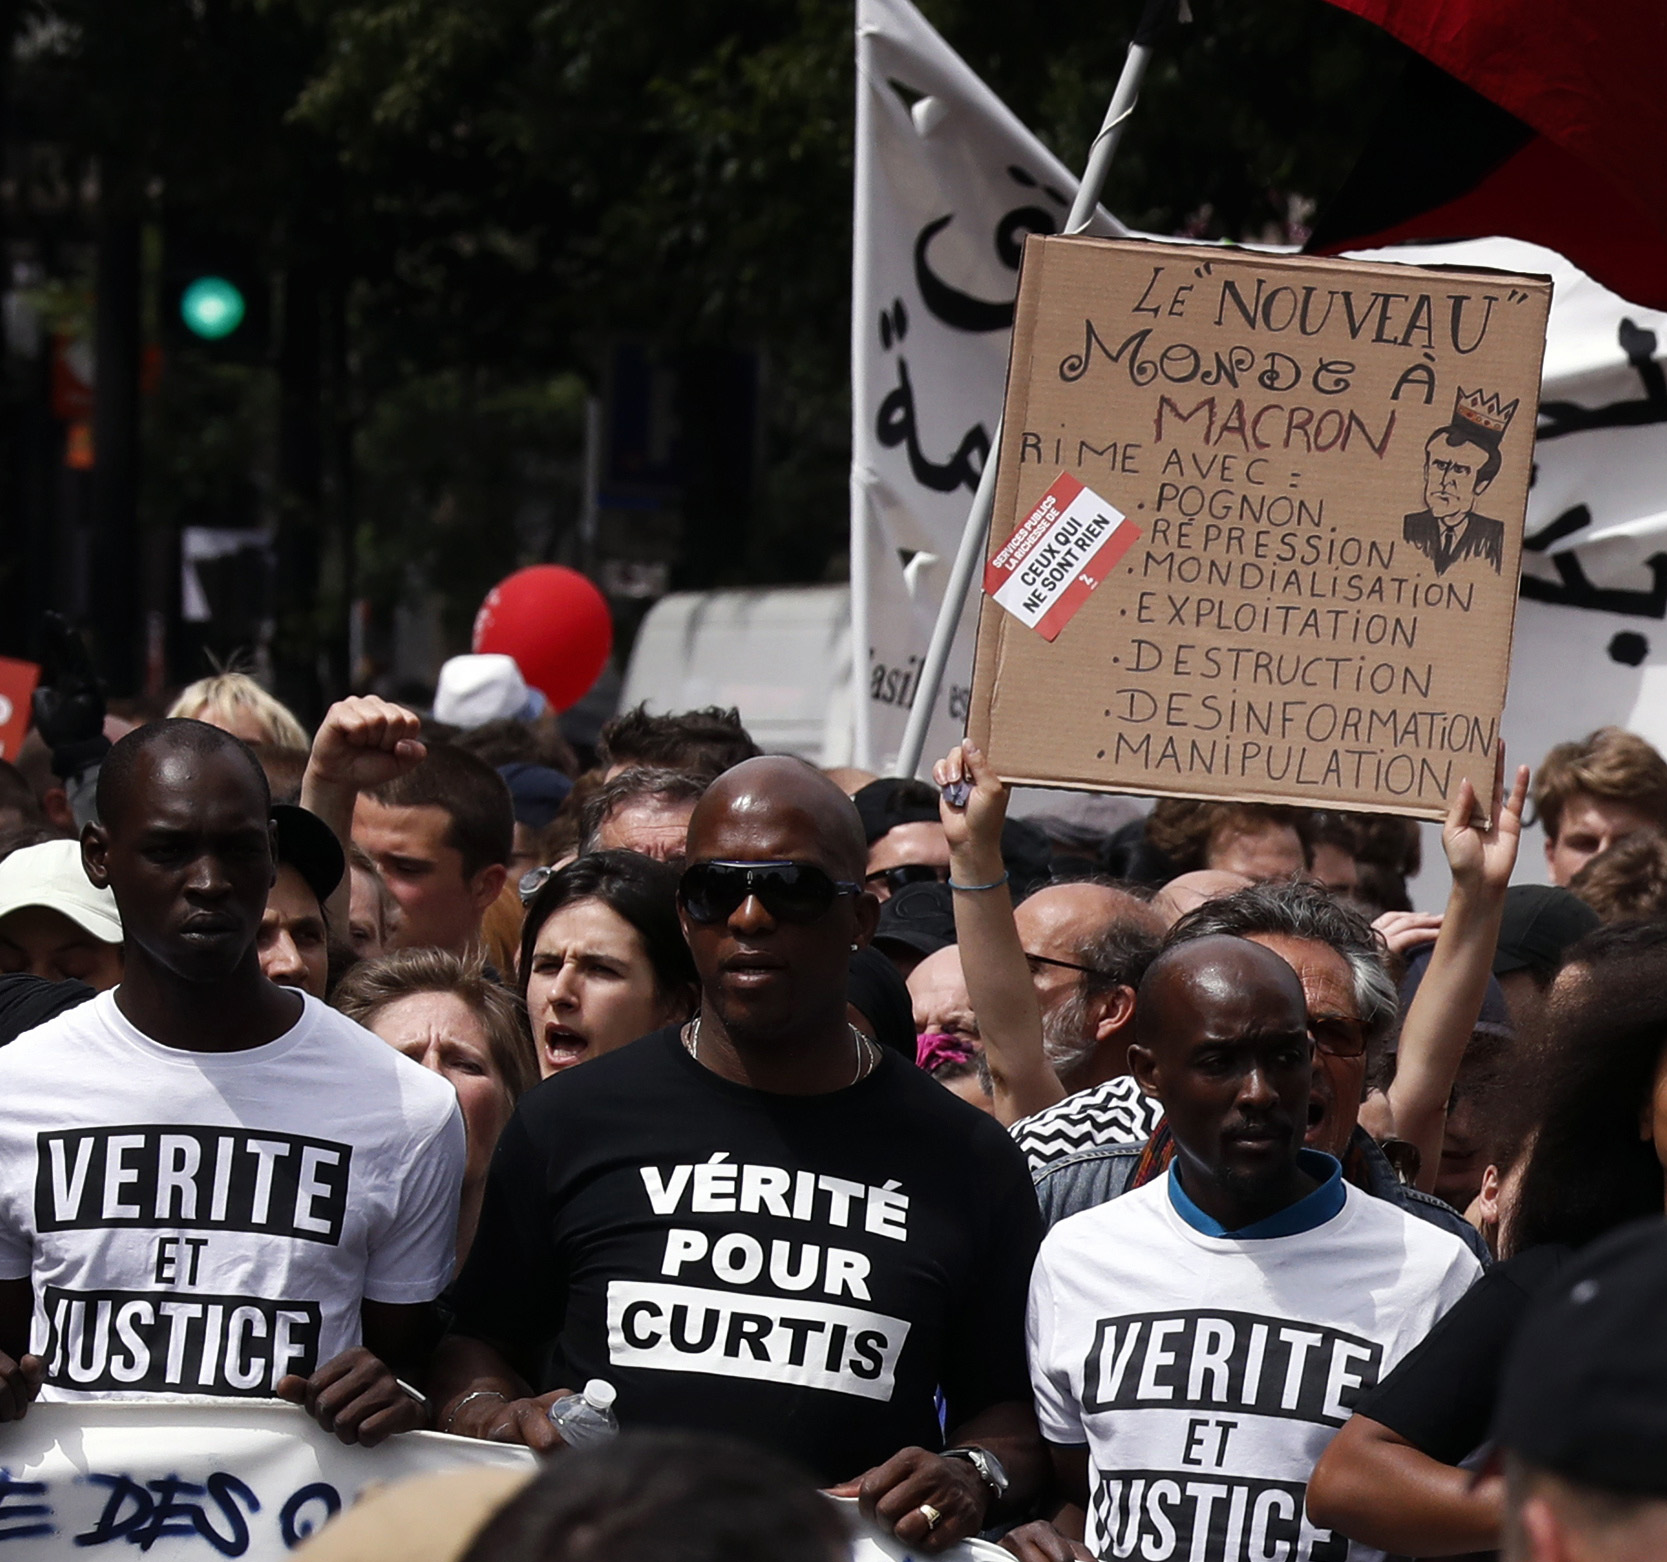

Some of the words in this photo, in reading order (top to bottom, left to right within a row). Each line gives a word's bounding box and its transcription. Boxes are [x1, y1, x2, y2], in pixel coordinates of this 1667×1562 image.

[1059, 320, 1355, 395] MONDE
[1391, 352, 1437, 404] À
[1153, 395, 1396, 460] MACRON
[1163, 449, 1268, 485] AVEC
[1023, 495, 1057, 533] PUBLICS
[1156, 483, 1323, 527] POGNON
[1020, 543, 1061, 587] CEUX
[1054, 516, 1083, 547] QUI
[1022, 588, 1048, 614] NE
[1041, 548, 1080, 592] SONT
[1074, 513, 1110, 553] RIEN
[48, 1133, 342, 1235] VERITE
[639, 1151, 910, 1242] VÉRITÉ
[154, 1237, 209, 1287] ET
[660, 1229, 872, 1301] POUR
[621, 1300, 889, 1381] CURTIS
[1095, 1317, 1372, 1421] VERITE
[1182, 1418, 1239, 1467] ET
[74, 1470, 261, 1560] DES
